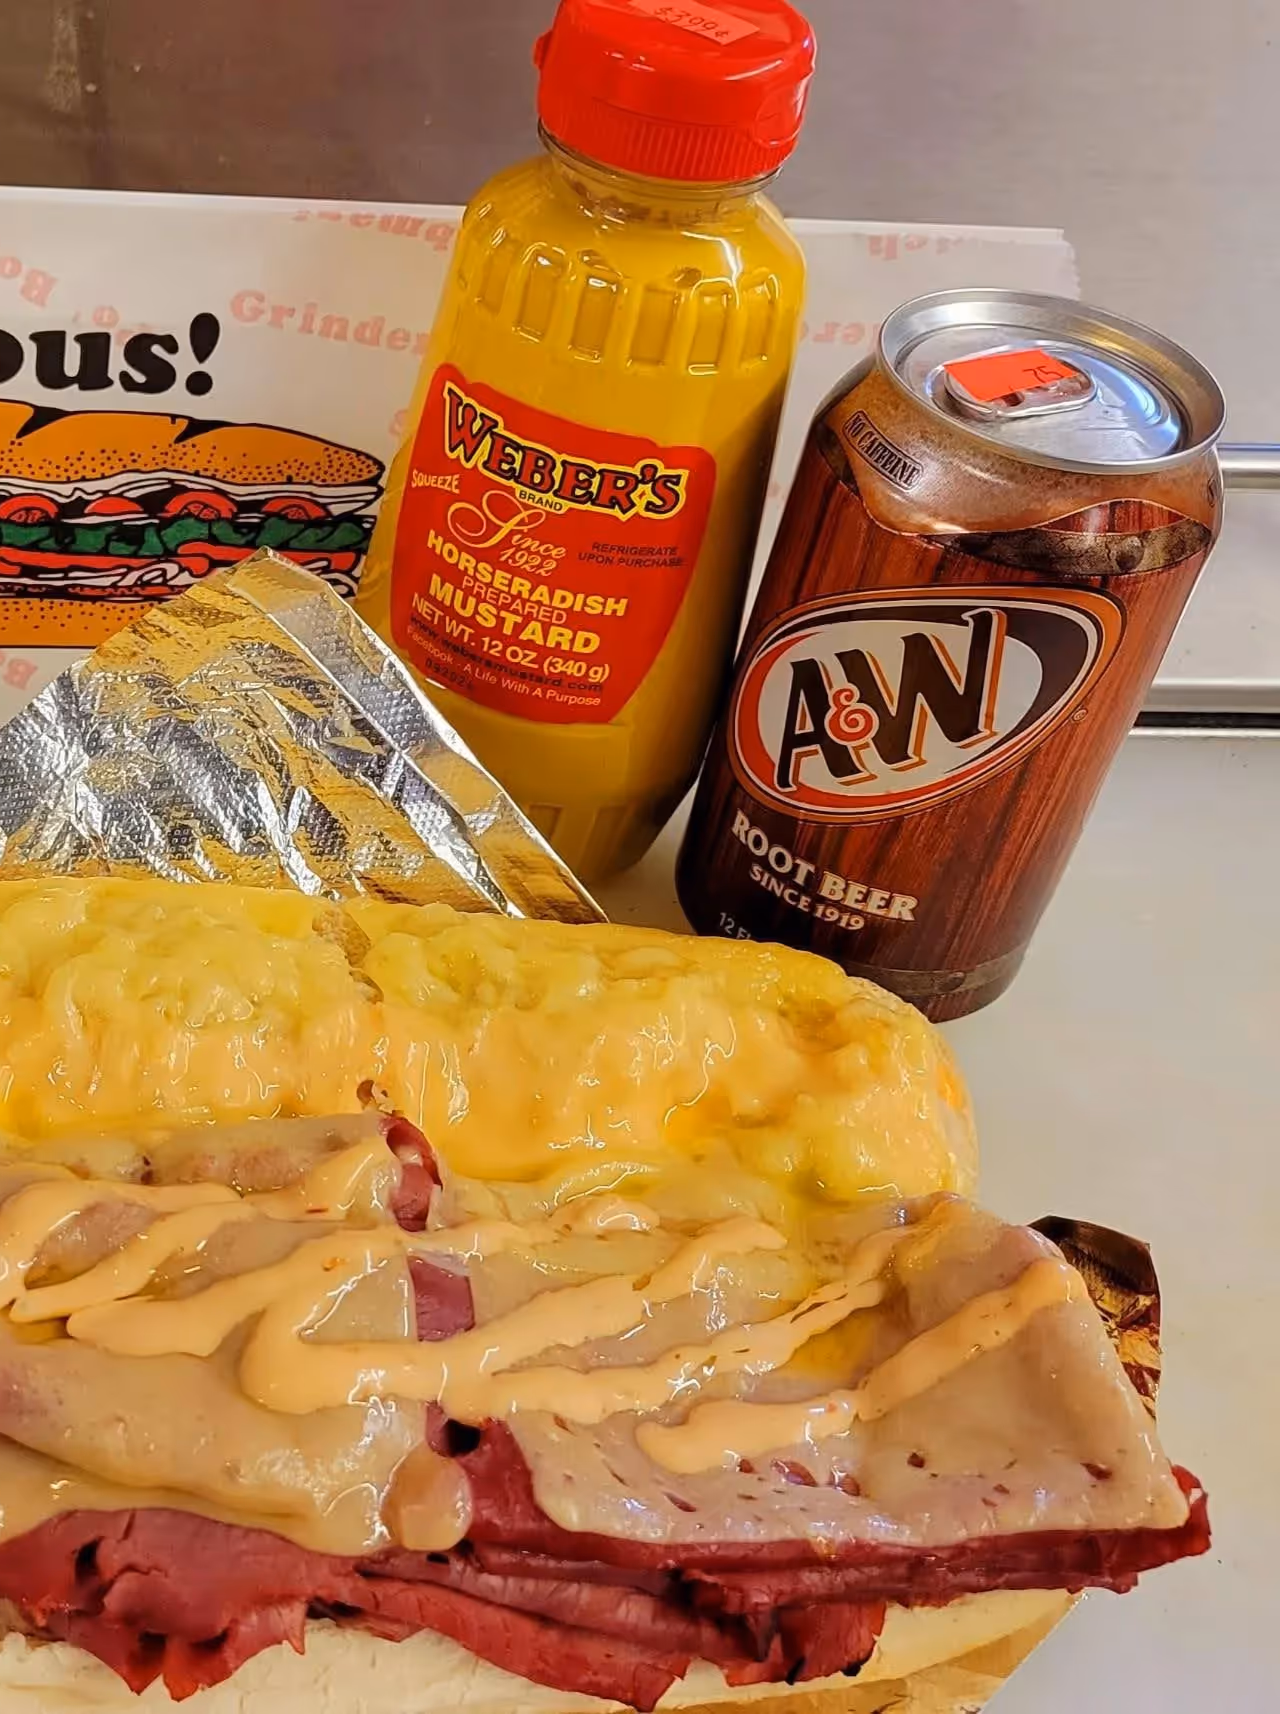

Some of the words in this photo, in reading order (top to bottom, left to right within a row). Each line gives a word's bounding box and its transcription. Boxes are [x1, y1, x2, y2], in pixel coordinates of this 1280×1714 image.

[411, 468, 460, 494] SQUEEZE
[443, 381, 690, 521] WEBER'S
[845, 414, 866, 438] NO
[857, 430, 921, 487] CAFFEINE
[447, 489, 567, 560] Since
[518, 489, 564, 513] BRAND
[427, 529, 628, 617] HORSERADISH
[500, 547, 560, 577] 1922
[578, 552, 614, 566] UPON
[618, 556, 686, 568] PURCHASE
[592, 541, 679, 556] REFRIGERATE
[429, 573, 601, 654] MUSTARD
[462, 575, 568, 625] PREPARED
[407, 625, 454, 665] Facebook
[463, 663, 473, 675] A
[475, 667, 497, 685] Life
[500, 678, 530, 695] With
[531, 687, 543, 698] A
[545, 689, 601, 706] Purpose
[412, 592, 444, 625] NET
[445, 615, 476, 647] WT.
[481, 637, 503, 657] 12
[505, 645, 539, 669] OZ
[543, 655, 587, 677] (340
[588, 663, 610, 684] g)
[773, 608, 1008, 792] A&W
[730, 808, 816, 887] ROOT
[817, 870, 919, 922] BEER
[749, 862, 812, 912] SINCE
[814, 903, 865, 931] 1919
[719, 912, 736, 936] 12
